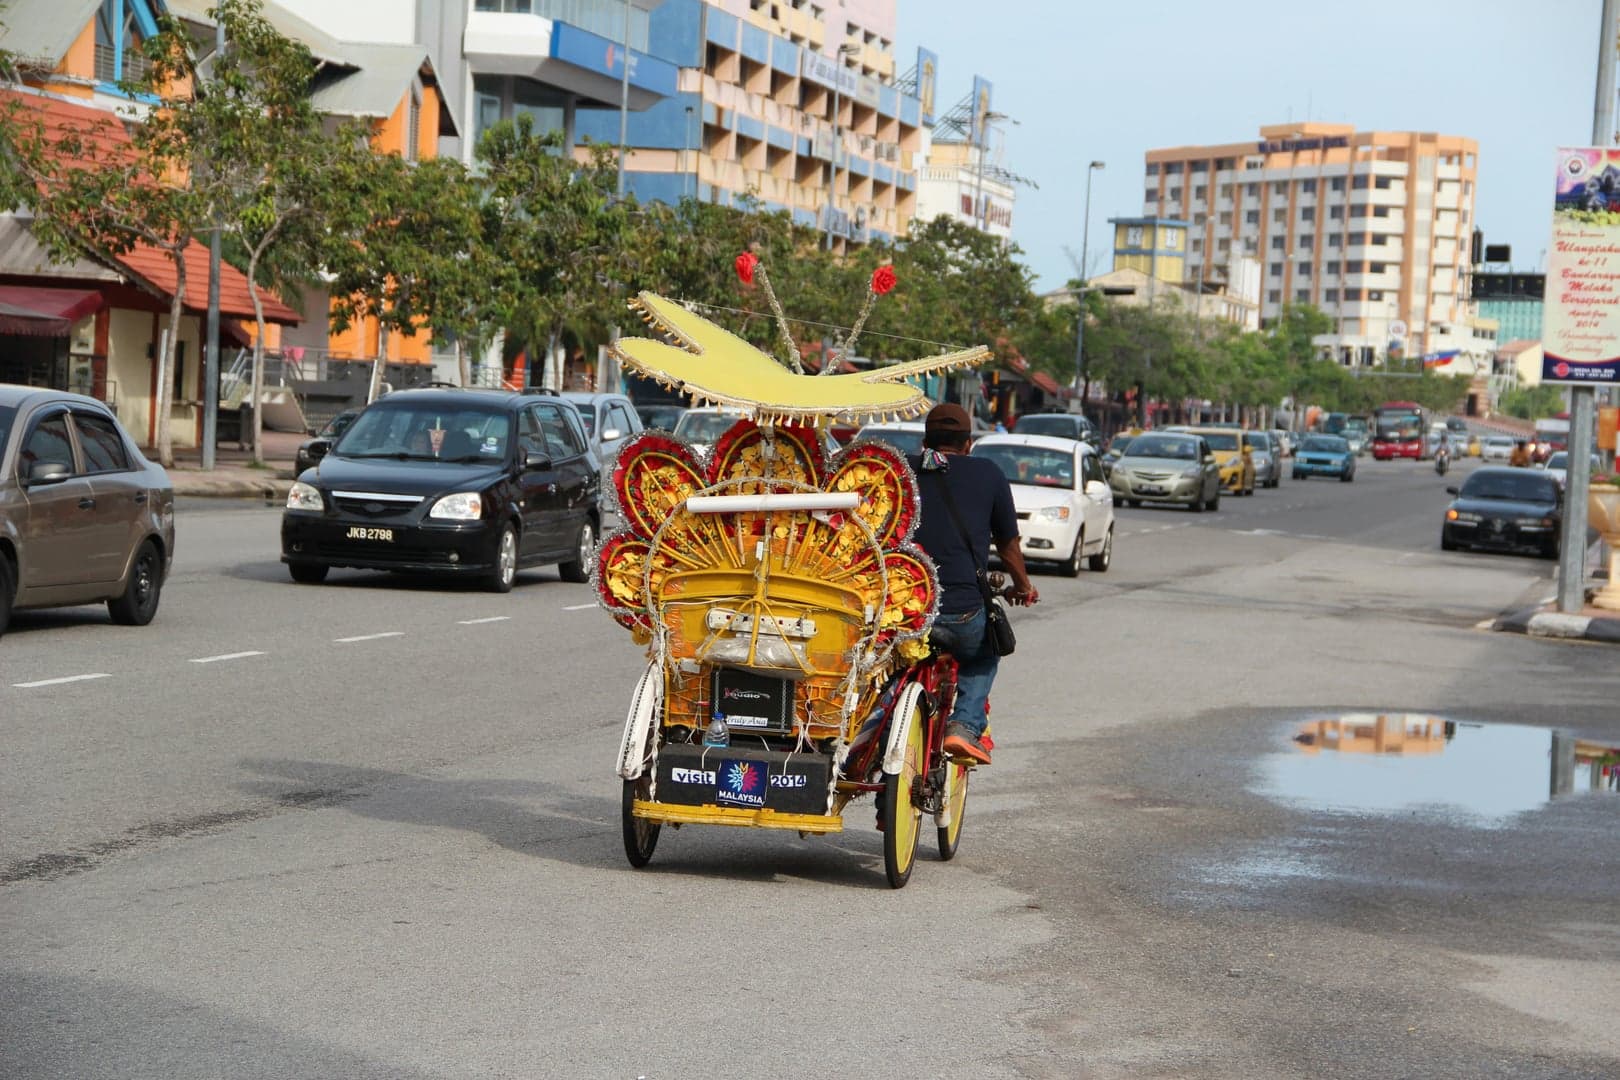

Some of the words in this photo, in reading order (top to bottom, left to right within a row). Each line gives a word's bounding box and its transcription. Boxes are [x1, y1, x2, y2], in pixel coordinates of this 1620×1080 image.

[677, 771, 712, 784] visit
[771, 775, 805, 787] 2014
[718, 790, 763, 804] MALAYSIA
